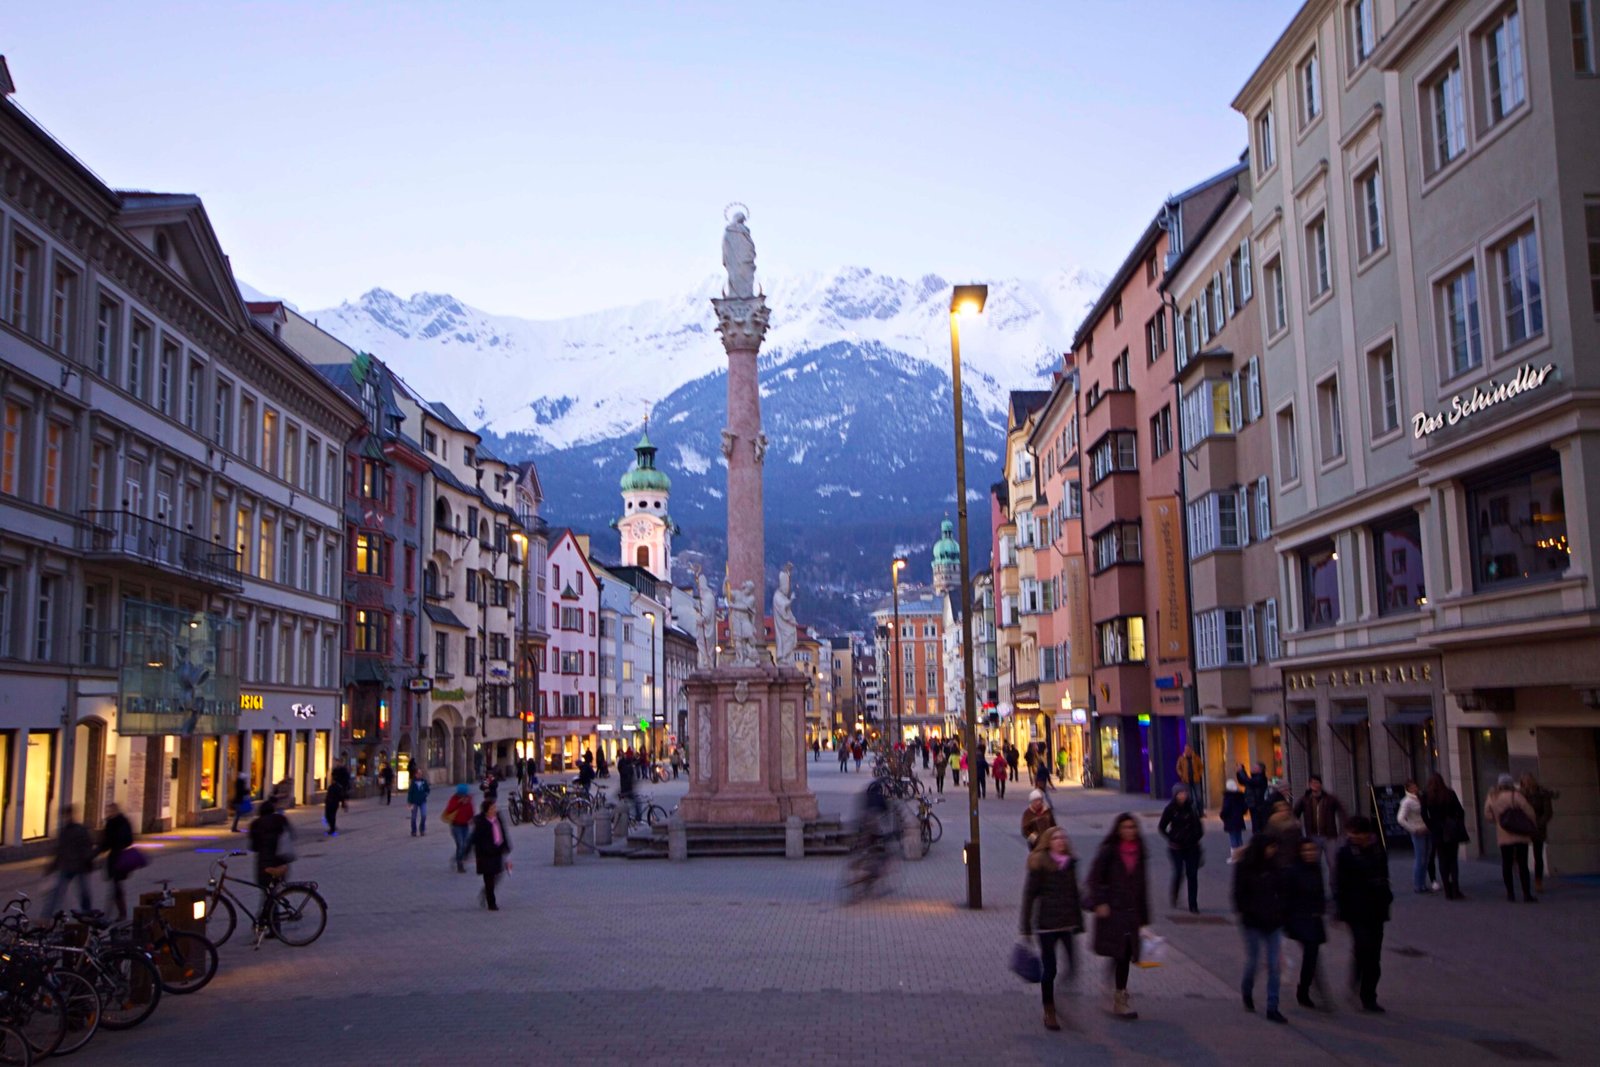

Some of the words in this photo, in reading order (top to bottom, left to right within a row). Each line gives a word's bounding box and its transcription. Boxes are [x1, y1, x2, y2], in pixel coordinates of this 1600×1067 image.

[1411, 411, 1443, 439] Das
[1448, 363, 1552, 426] Schindler
[1290, 672, 1316, 690] BAR
[1329, 662, 1432, 688] CENTRALE
